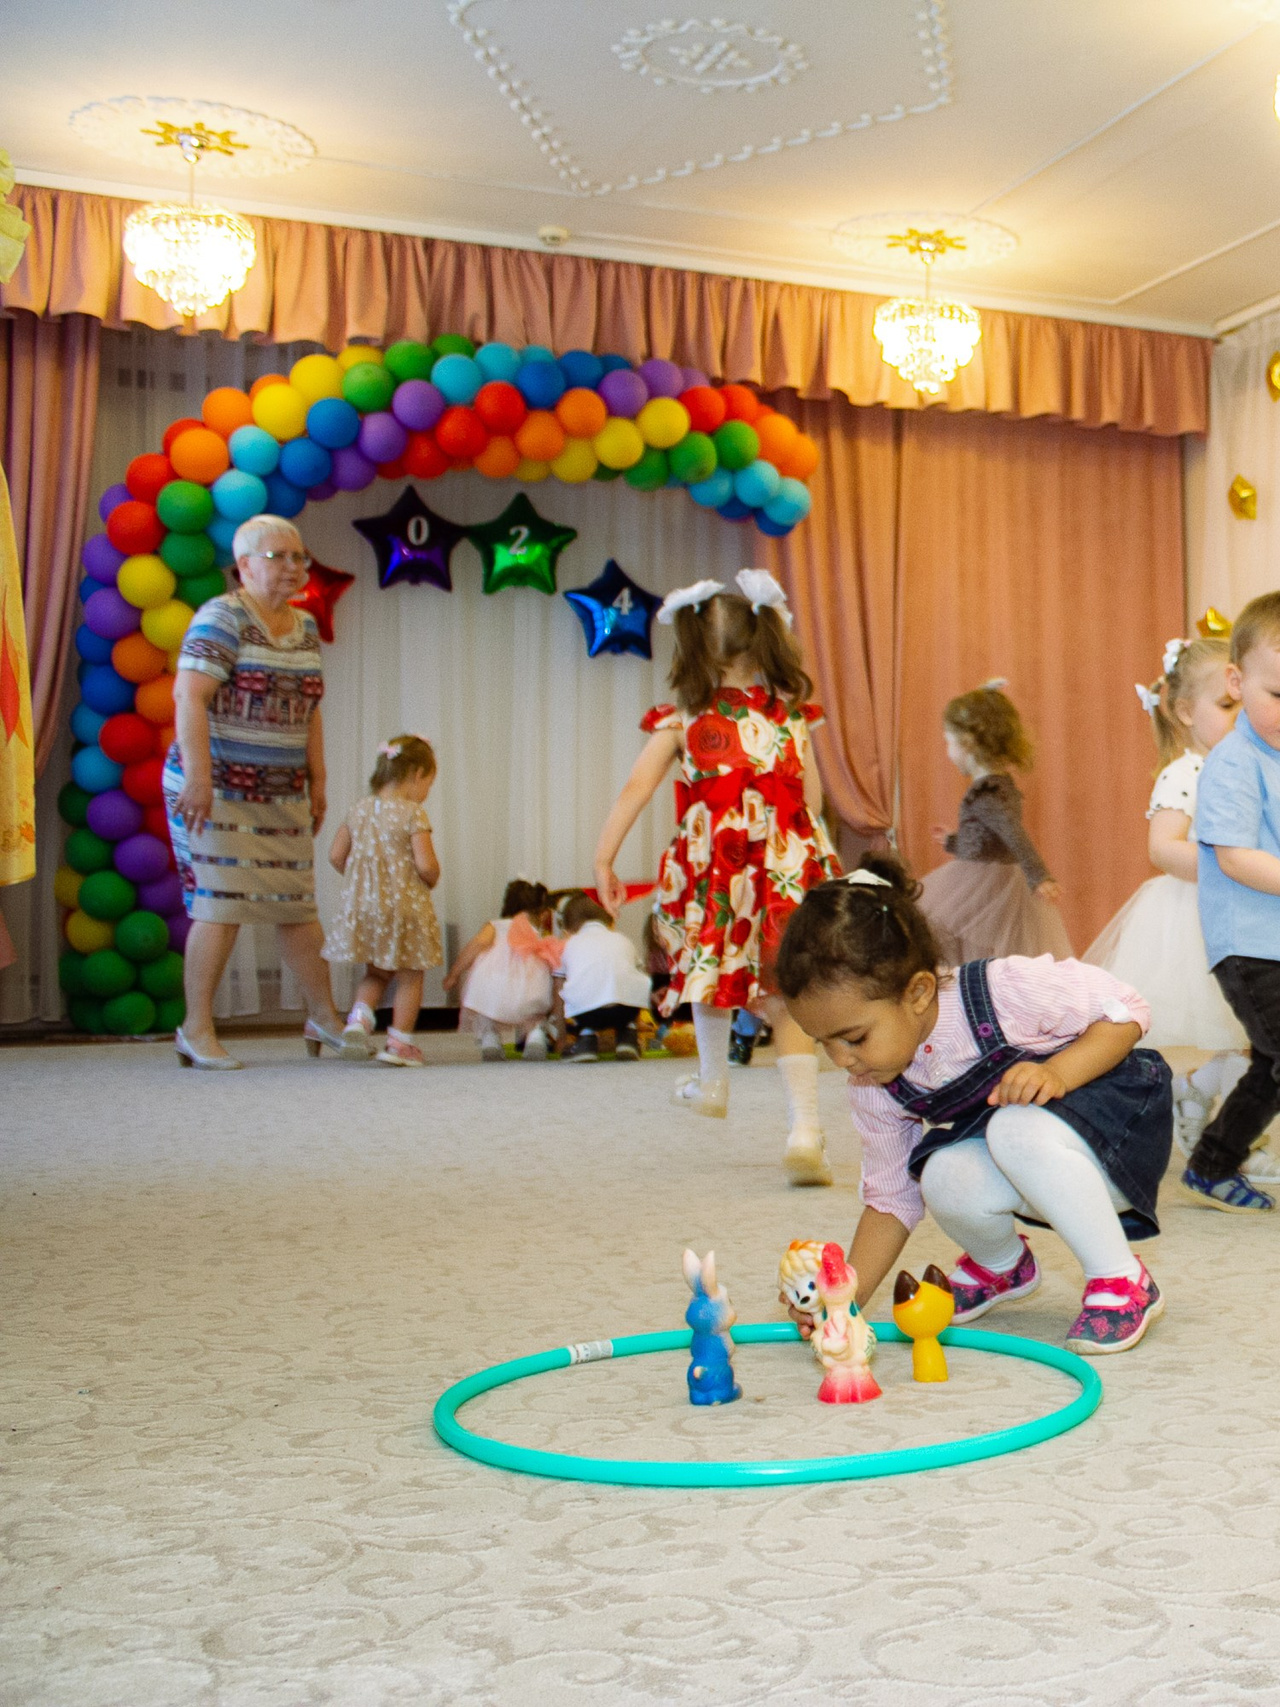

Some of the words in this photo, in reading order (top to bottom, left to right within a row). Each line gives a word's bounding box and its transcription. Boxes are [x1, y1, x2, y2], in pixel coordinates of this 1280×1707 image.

[407, 516, 429, 546] 0
[509, 525, 530, 555] 2
[612, 586, 634, 616] 4
